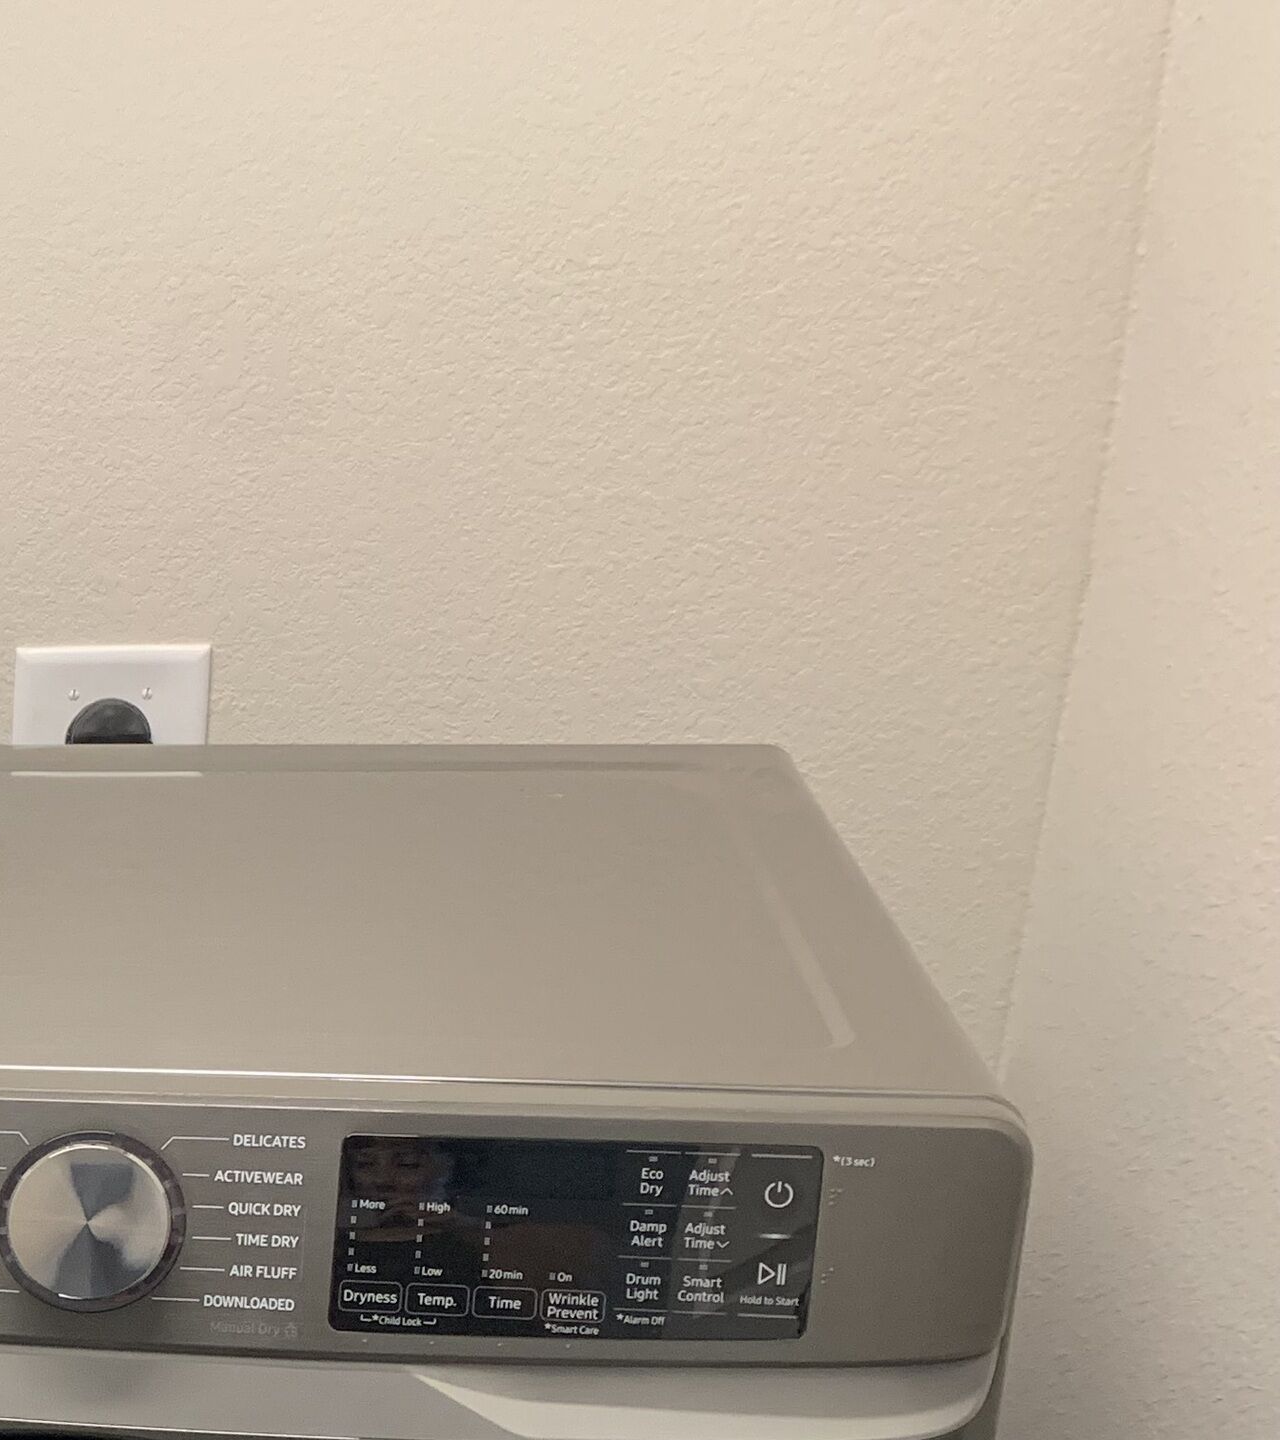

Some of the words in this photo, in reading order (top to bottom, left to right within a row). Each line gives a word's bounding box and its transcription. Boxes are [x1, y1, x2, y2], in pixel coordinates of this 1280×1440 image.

[233, 1134, 306, 1149] DELICATES
[214, 1170, 303, 1185] ACTIVEWEAR
[641, 1168, 664, 1180] Eco
[689, 1169, 730, 1183] Adjust
[640, 1182, 664, 1197] Dry
[228, 1201, 271, 1216] QUICK
[273, 1203, 301, 1217] DRY
[359, 1199, 385, 1210] More
[427, 1202, 451, 1214] High
[630, 1220, 667, 1234] Damp
[685, 1222, 726, 1236] Adjust
[236, 1233, 268, 1247] TIME
[271, 1235, 299, 1248] DRY
[631, 1235, 664, 1248] Alert
[229, 1264, 253, 1278] AIR
[256, 1266, 298, 1280] FLUFF
[354, 1263, 377, 1274] Less
[421, 1266, 443, 1277] Low
[557, 1272, 573, 1282] On
[626, 1273, 661, 1286] Drum
[683, 1275, 722, 1288] Smart
[343, 1288, 398, 1306] Dryness
[417, 1292, 457, 1308] Temp.
[548, 1292, 599, 1306] Wrinkle
[626, 1287, 659, 1303] Light
[677, 1290, 724, 1304] Control
[740, 1295, 762, 1306] Hold
[764, 1296, 774, 1306] to
[775, 1296, 800, 1307] Start
[204, 1294, 295, 1311] DOWNLOADED
[489, 1295, 522, 1310] Time
[547, 1306, 598, 1321] Prevent
[402, 1315, 422, 1327] Lock
[651, 1316, 665, 1326] Off
[579, 1325, 599, 1336] Care
